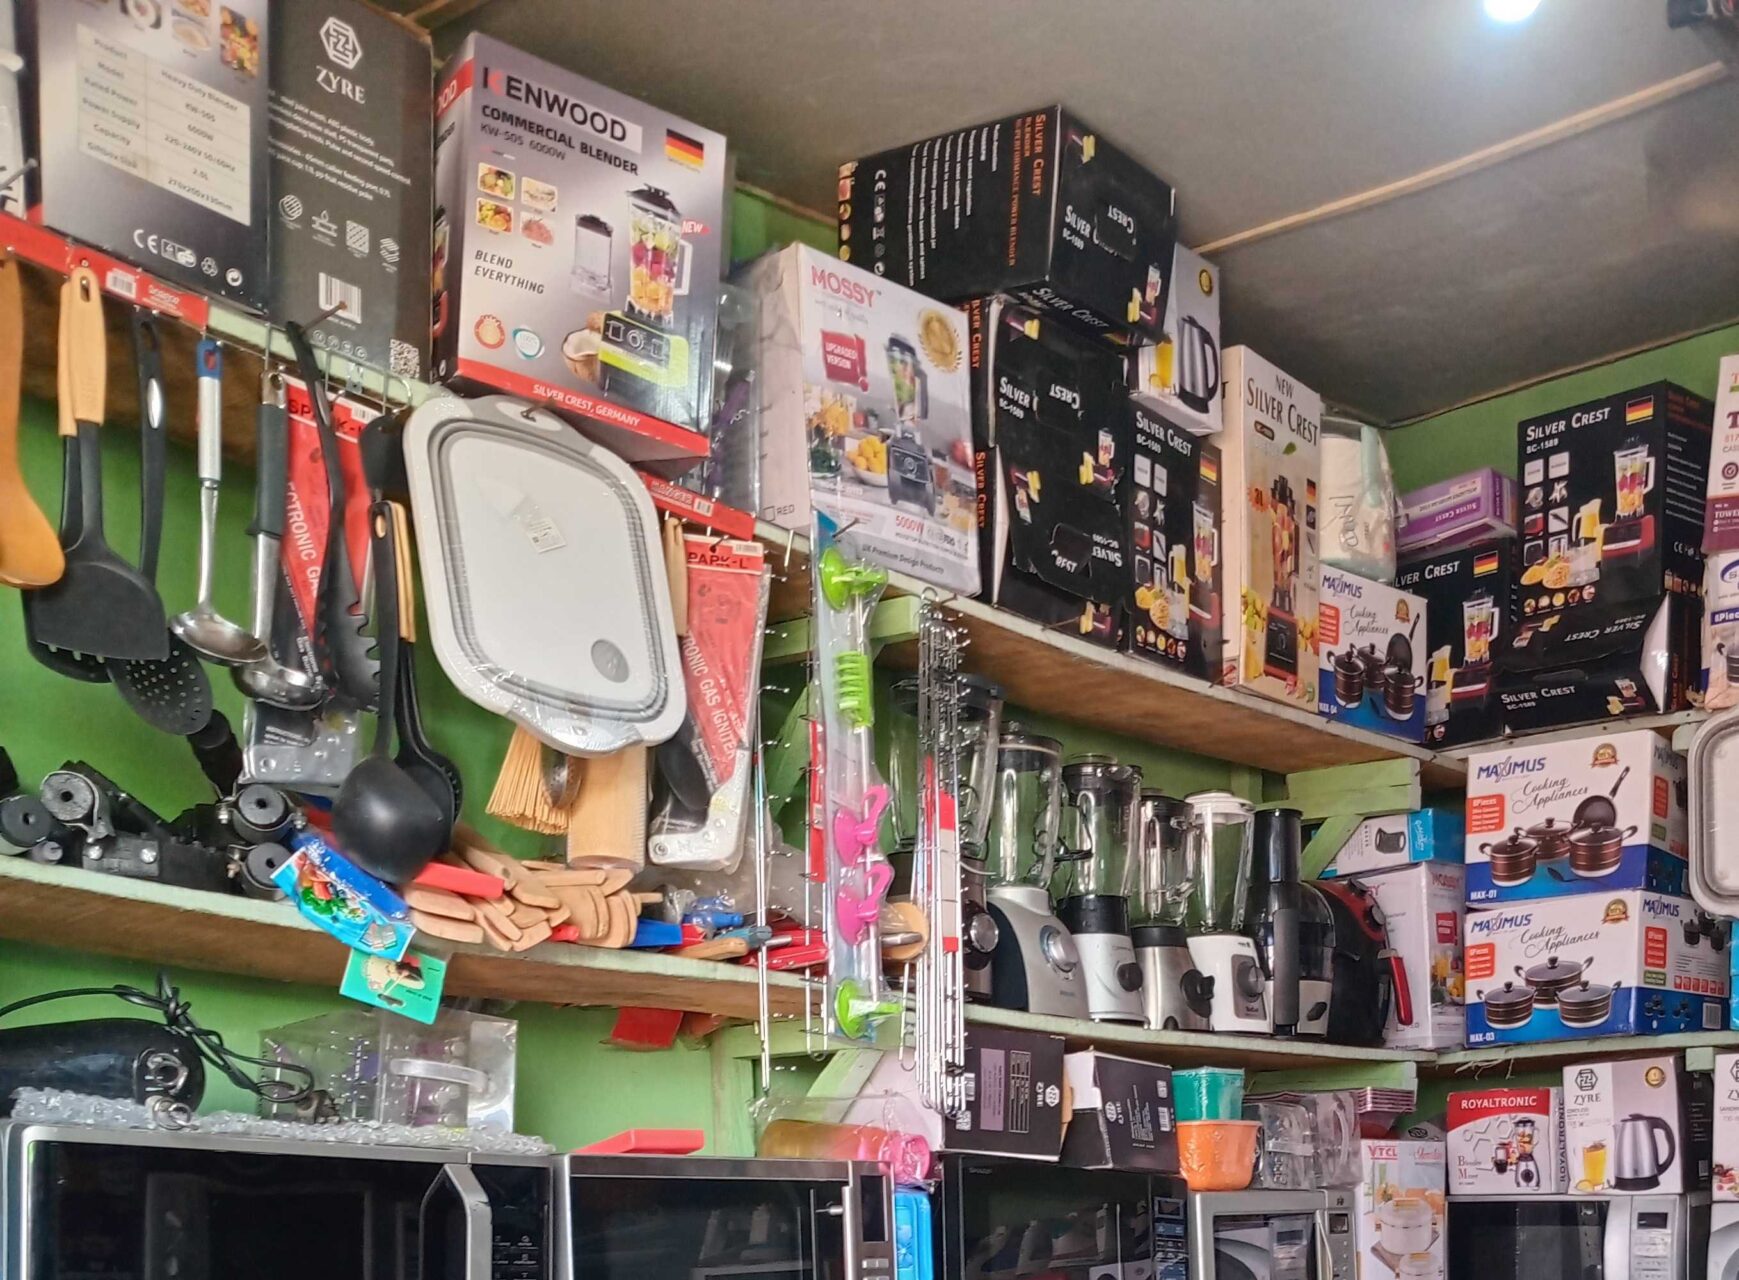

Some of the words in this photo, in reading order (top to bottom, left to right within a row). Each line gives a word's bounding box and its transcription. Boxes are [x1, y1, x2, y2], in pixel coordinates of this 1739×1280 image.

[98, 61, 126, 80] Model
[316, 65, 366, 105] ZYRE
[480, 122, 525, 146] KW-505
[481, 104, 576, 149] COMMERCIAL
[580, 142, 639, 176] BLENDER
[1034, 113, 1047, 158] SILVER
[1031, 158, 1045, 197] CREST
[682, 220, 704, 234] NEW
[1064, 204, 1092, 239] SILVER
[1106, 204, 1135, 235] CREST
[475, 250, 513, 270] BLEND
[474, 265, 546, 295] EVERYTHING
[811, 265, 875, 308] MOSSY
[1031, 286, 1075, 312] SILVER
[971, 299, 982, 329] ILVER
[825, 341, 857, 361] UPGRADED
[826, 354, 852, 370] VERSION
[971, 332, 982, 369] CREST
[999, 376, 1031, 409] SILVER
[1048, 383, 1080, 409] CREST
[1275, 374, 1295, 400] NEW
[533, 383, 565, 404] SILVER
[595, 402, 641, 428] GERMANY
[1247, 377, 1283, 425] SILVER
[1287, 403, 1319, 447] CREST
[1135, 410, 1165, 441] SILVER
[1166, 428, 1193, 457] CREST
[1525, 419, 1567, 442] SILVER
[1571, 407, 1612, 429] CREST
[975, 451, 986, 491] SILVER
[776, 503, 795, 516] RED
[977, 493, 987, 529] CREST
[1321, 574, 1364, 598] MAXIMUS
[1393, 571, 1421, 589] LVER
[1424, 560, 1461, 581] CREST
[1345, 603, 1378, 623] Cooking
[1344, 620, 1389, 636] Appliances
[1563, 628, 1601, 644] CREST
[1603, 619, 1644, 635] SILVER
[1500, 690, 1539, 705] SILVER
[1540, 685, 1577, 699] CREST
[699, 678, 721, 707] GAS
[711, 708, 738, 761] IGNITER
[1476, 756, 1548, 783] MAXIMUS
[1522, 776, 1570, 797] Cooking
[1512, 786, 1589, 815] Appliances
[1470, 890, 1497, 900] MAX-01
[1642, 897, 1680, 918] MAXIMUS
[1470, 913, 1534, 937] MAXIMUS
[1520, 925, 1567, 945] Cooking
[1524, 930, 1601, 958] Appliances
[1469, 1032, 1496, 1043] MAX-03
[1035, 1081, 1044, 1108] ZYRE
[1461, 1096, 1537, 1110] ROYALTRONIC
[1574, 1093, 1601, 1106] ZYRE
[1558, 1098, 1566, 1183] ROYALTRONIC
